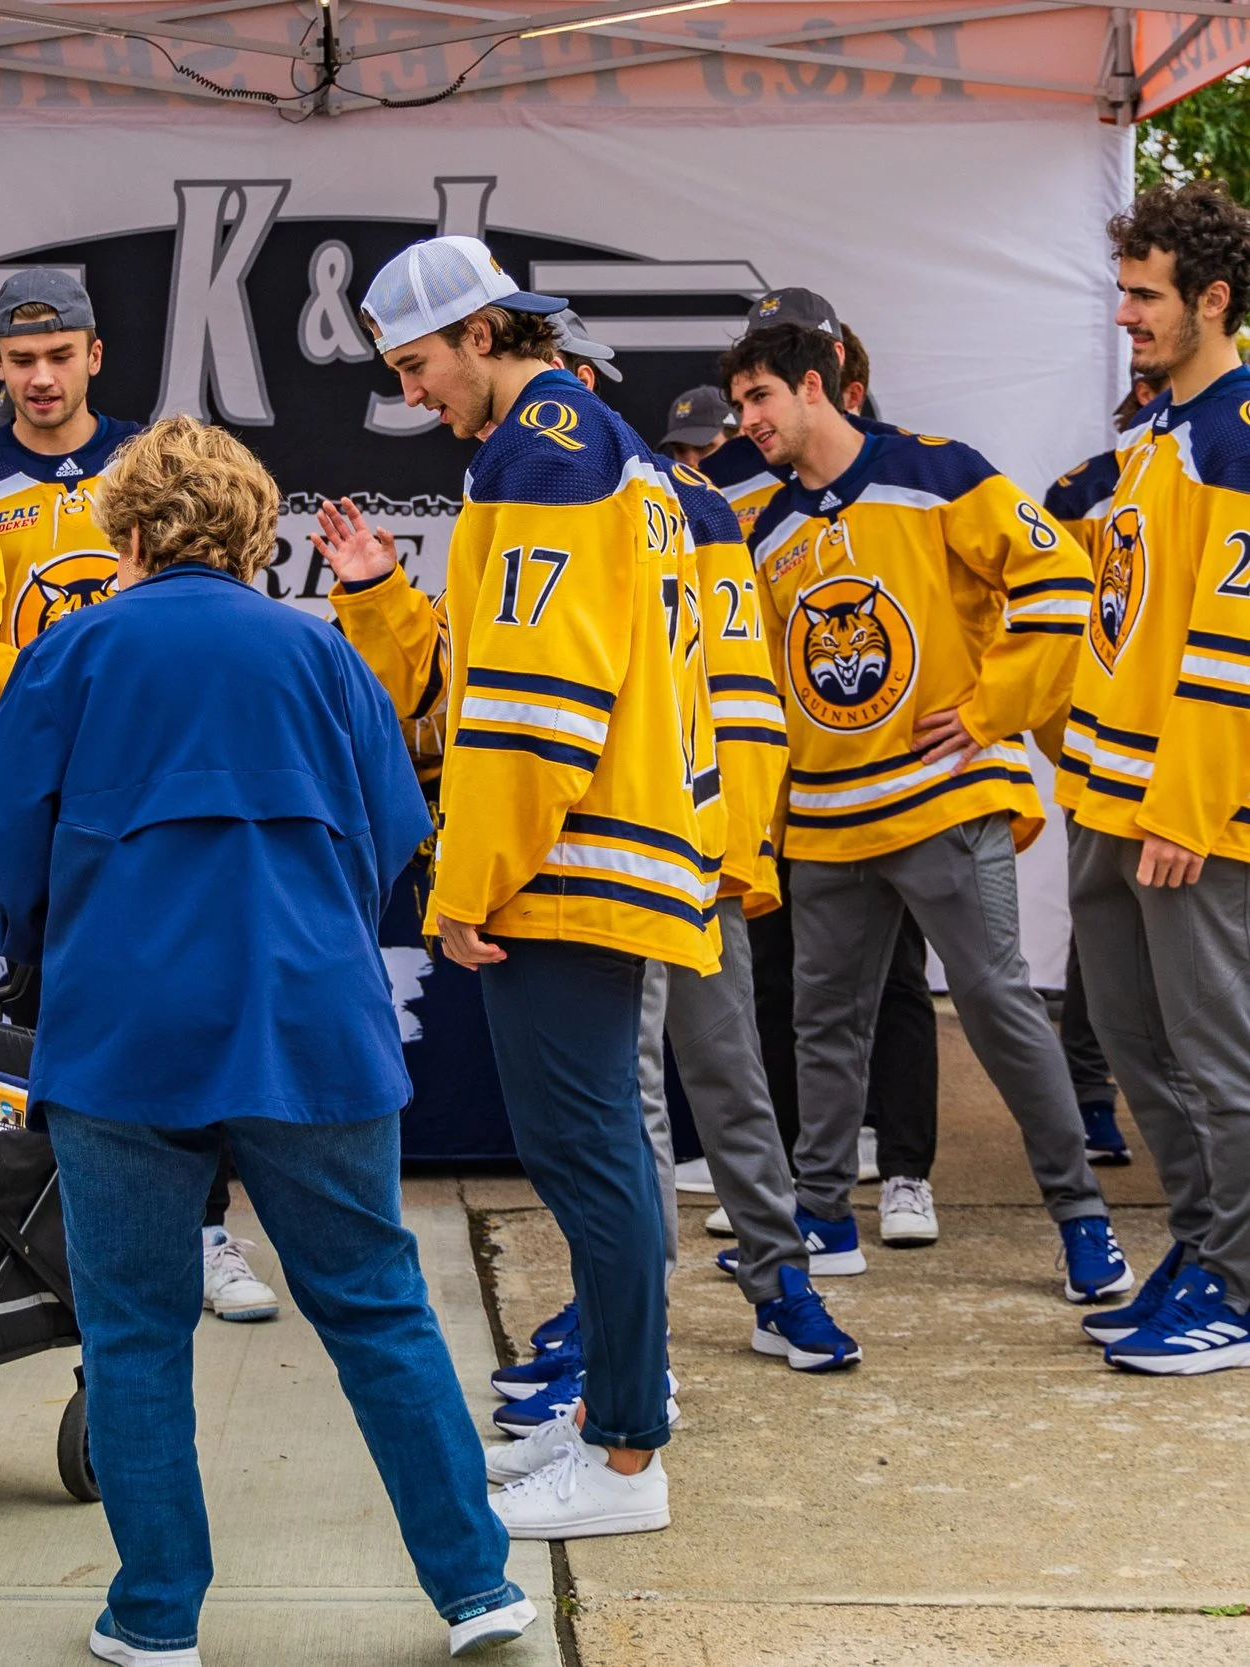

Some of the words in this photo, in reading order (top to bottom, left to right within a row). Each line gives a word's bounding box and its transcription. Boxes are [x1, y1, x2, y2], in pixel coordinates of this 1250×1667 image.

[55, 468, 84, 477] adidas
[1015, 500, 1058, 555] 8
[774, 538, 810, 570] ECAC
[494, 545, 572, 627] 17
[800, 670, 906, 724] QUINNIPIAC
[457, 1606, 487, 1621] adidas
